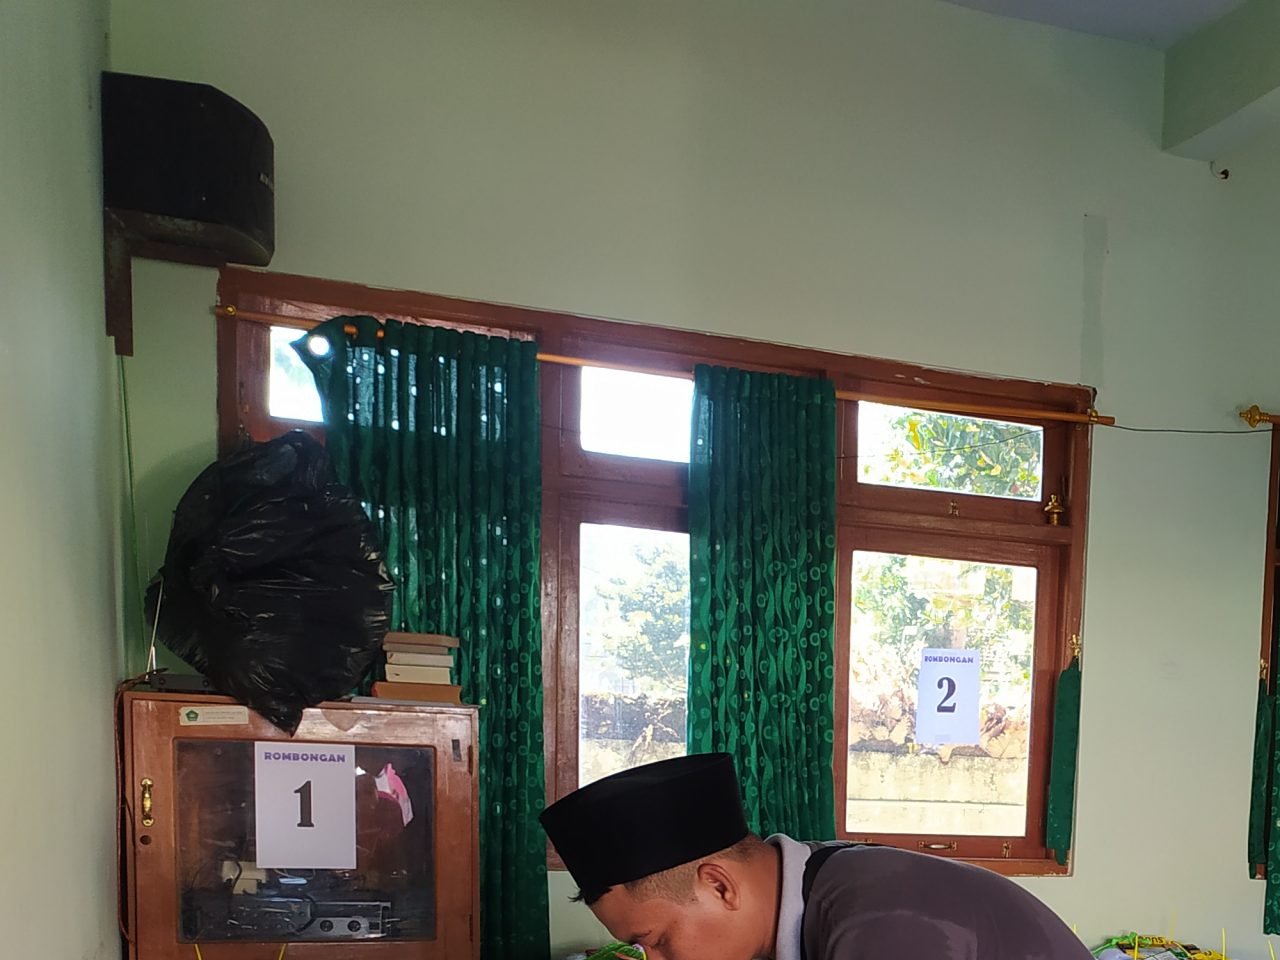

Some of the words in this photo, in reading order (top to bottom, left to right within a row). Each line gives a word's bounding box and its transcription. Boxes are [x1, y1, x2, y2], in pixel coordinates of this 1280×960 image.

[924, 655, 974, 664] ROMBONGAN
[936, 676, 957, 713] 2
[264, 751, 346, 763] ROMBONGAN
[293, 779, 315, 828] 1
